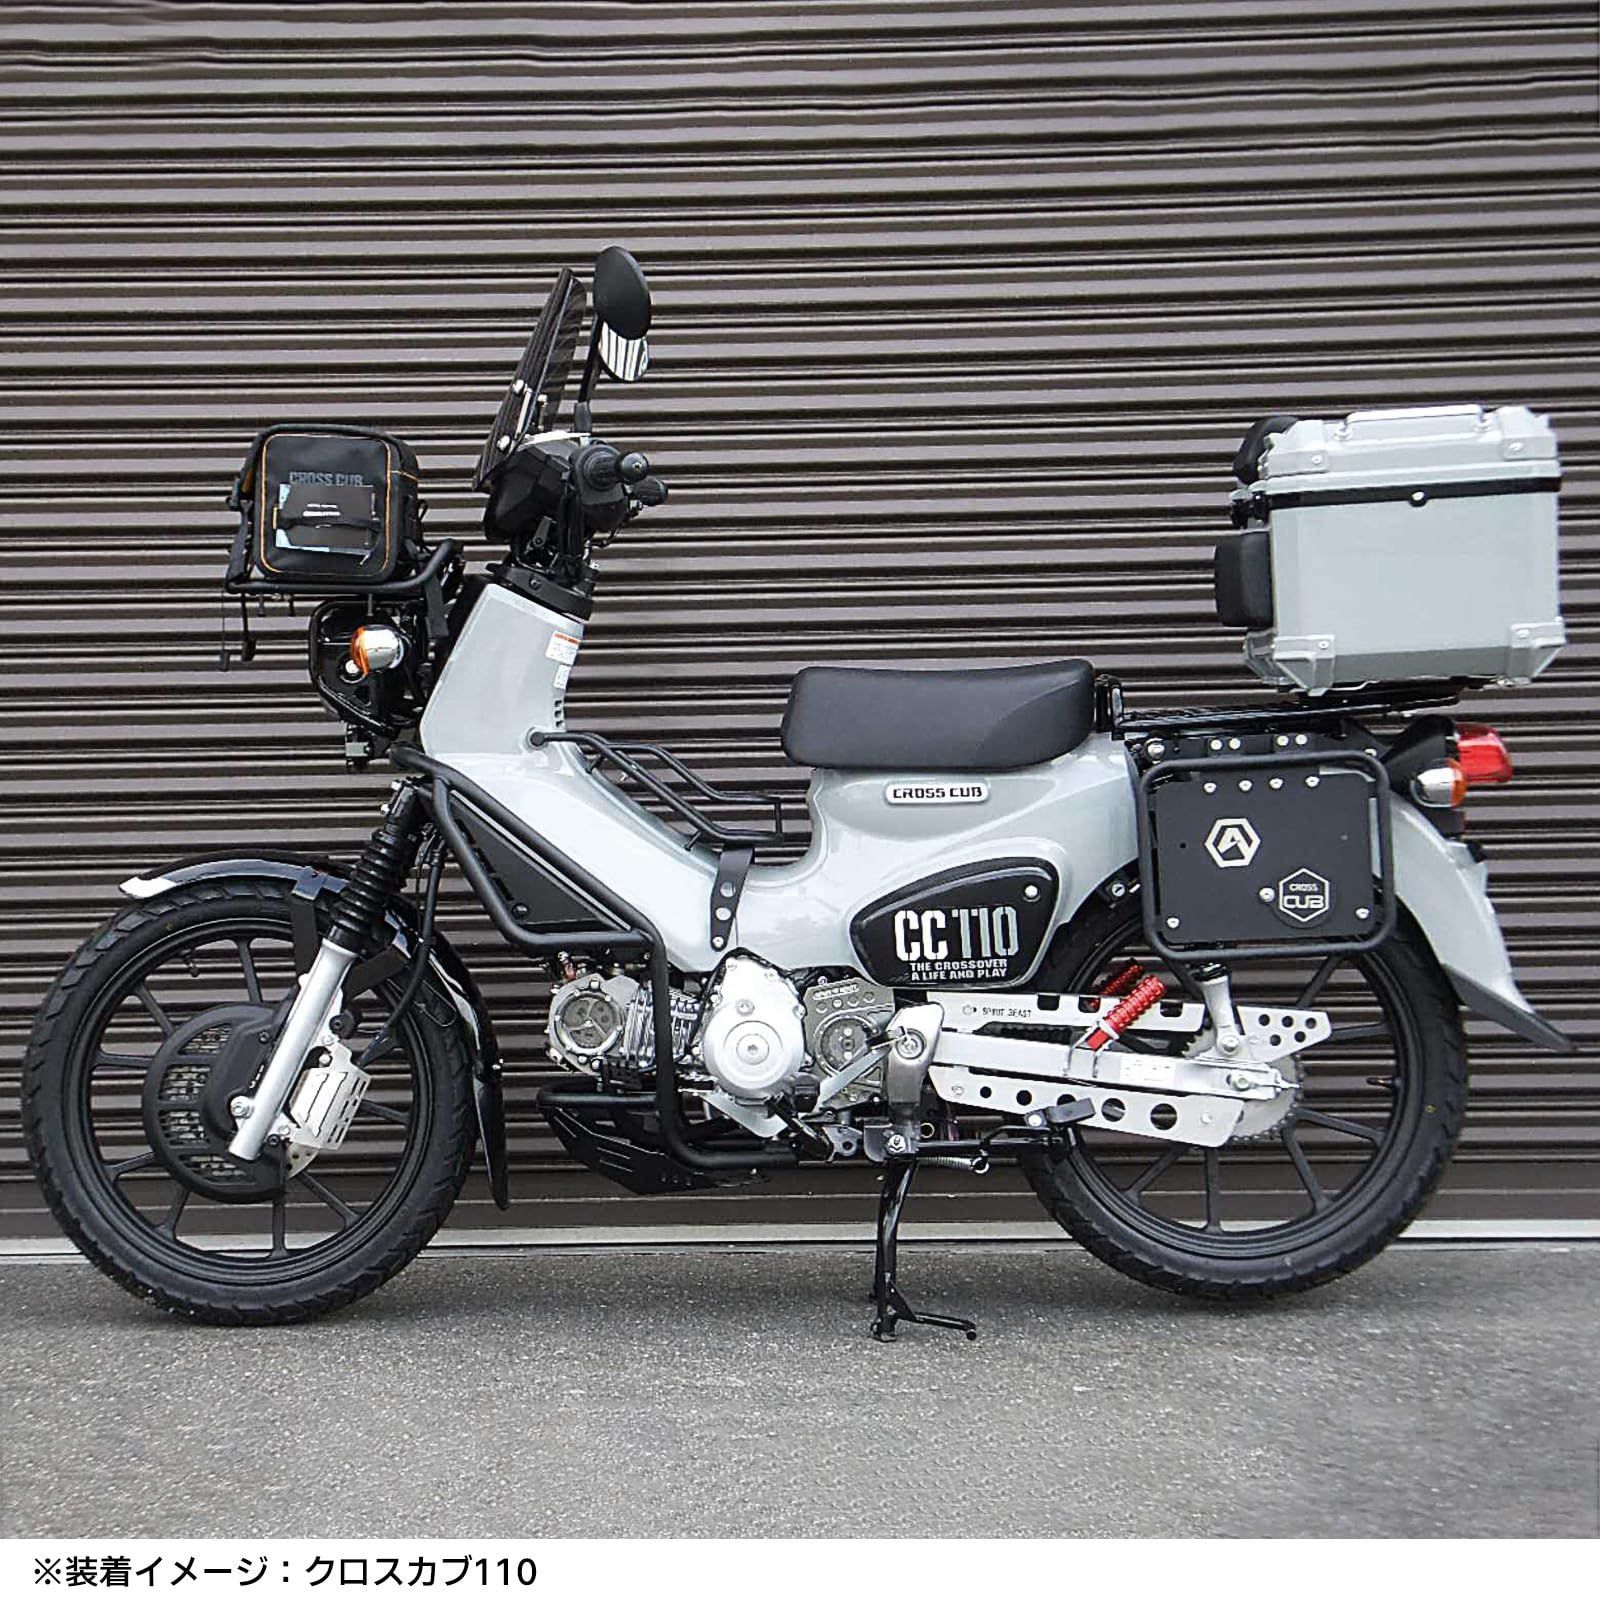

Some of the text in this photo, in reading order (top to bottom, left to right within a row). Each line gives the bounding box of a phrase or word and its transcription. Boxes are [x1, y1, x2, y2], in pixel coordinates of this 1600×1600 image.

[289, 471, 364, 488] CROSS CUB
[893, 786, 983, 799] CROSS CUB
[1288, 883, 1319, 892] CROSS
[1283, 894, 1325, 909] CUB
[909, 959, 1008, 972] THE CROSSOVER
[911, 968, 1008, 981] A LIFE AND PLAY
